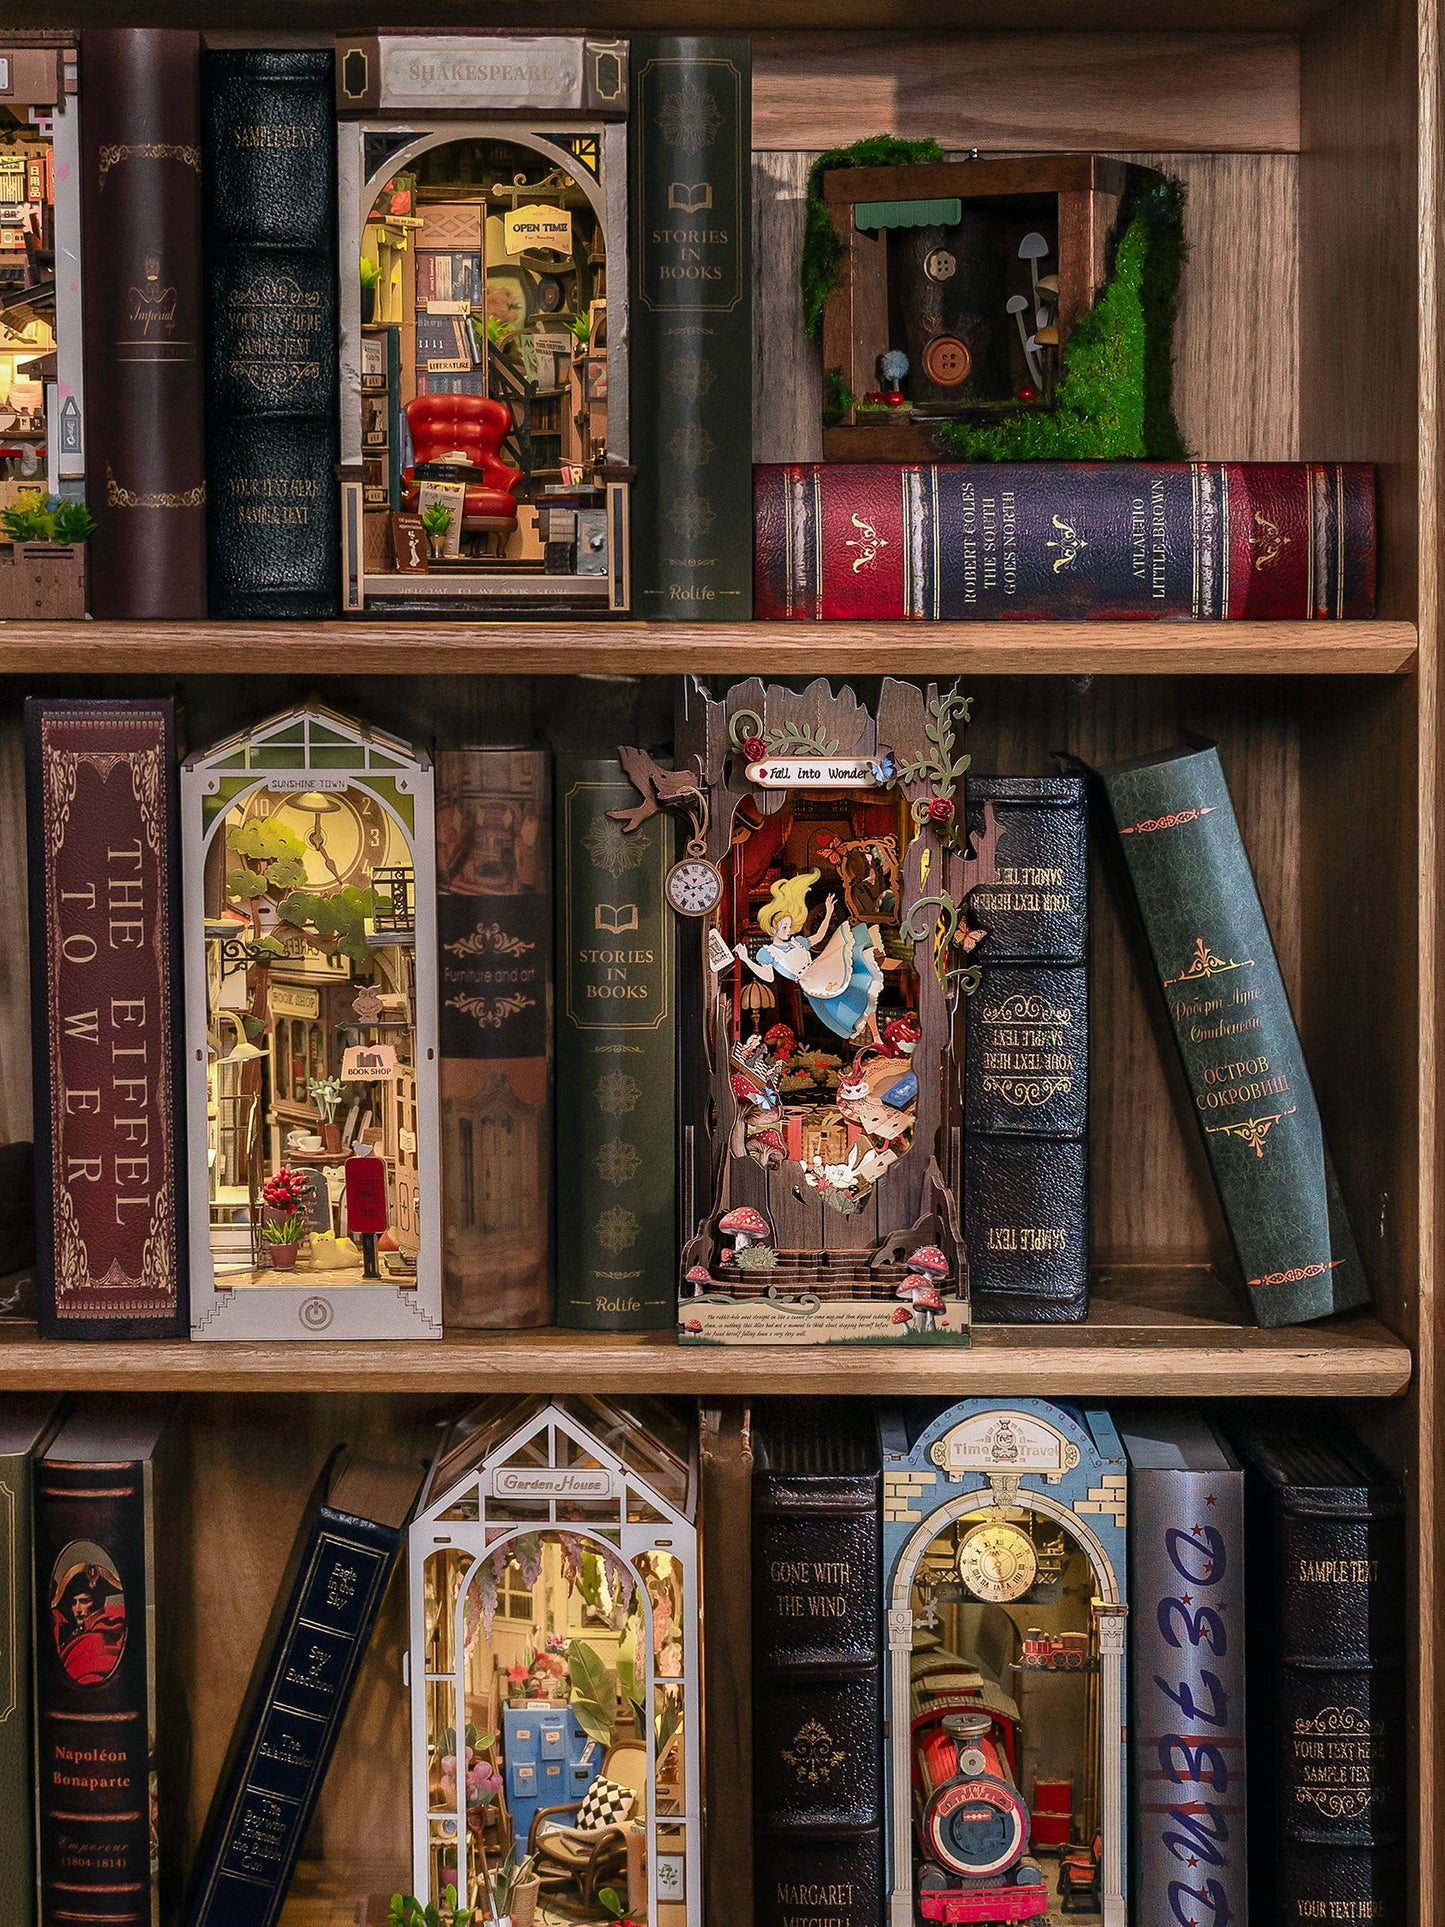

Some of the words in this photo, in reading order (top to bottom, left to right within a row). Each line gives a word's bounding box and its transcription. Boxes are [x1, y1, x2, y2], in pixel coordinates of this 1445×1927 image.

[409, 64, 555, 82] SHAKESPEARE
[513, 223, 540, 233] OPEN
[543, 223, 568, 232] TIME
[652, 229, 729, 244] STORIES
[680, 248, 702, 262] IN
[659, 264, 723, 280] BOOKS
[428, 361, 470, 371] LITERATURE
[962, 482, 976, 535] COLES
[1151, 480, 1165, 538] BROWN
[982, 498, 996, 552] SOUTH
[1002, 491, 1016, 547] NORTH
[964, 539, 977, 604] ROBERT
[983, 557, 997, 590] THE
[1004, 551, 1017, 595] GOES
[1152, 543, 1166, 599] LITTLE
[668, 585, 716, 601] Rolife
[769, 766, 792, 780] Fall
[797, 766, 822, 780] into
[828, 766, 870, 780] Wonder
[271, 779, 316, 789] SUNSHINE
[319, 779, 346, 789] TOWN
[361, 798, 373, 816] 2
[370, 829, 380, 848] 3
[1021, 867, 1064, 886] SAMPLE
[107, 838, 145, 951] THE
[1013, 893, 1040, 911] TEXT
[579, 949, 655, 964] STORIES
[444, 966, 492, 984] Furniture
[494, 968, 519, 983] and
[519, 968, 535, 982] art
[606, 967, 628, 982] IN
[272, 992, 294, 1005] BOOK
[295, 995, 316, 1008] SHOP
[586, 984, 649, 999] BOOKS
[1170, 996, 1224, 1022] Роберт
[60, 882, 103, 1185] TOWER
[992, 1030, 1020, 1047] TEXT
[982, 1053, 1012, 1070] HERE
[1013, 1053, 1041, 1070] TEXT
[1043, 1053, 1074, 1070] YOUR
[1203, 1056, 1270, 1085] ОСТРОВ
[1196, 1075, 1291, 1110] СОКРОВИЩ
[110, 995, 151, 1226] EIFFEL
[987, 1228, 1018, 1250] TEXT
[1019, 1228, 1067, 1250] SAMPLE
[595, 1296, 641, 1312] Rolife
[953, 1443, 990, 1455] Time
[1018, 1445, 1060, 1457] Travel
[503, 1473, 553, 1491] Garden
[553, 1474, 602, 1492] House
[332, 1562, 357, 1582] Eagle
[770, 1561, 810, 1584] GONE
[813, 1561, 850, 1585] WITH
[1300, 1560, 1348, 1582] SAMPLE
[1349, 1560, 1379, 1582] TEXT
[326, 1591, 348, 1610] Sky
[776, 1595, 805, 1617] THE
[807, 1595, 847, 1617] WIND
[285, 1667, 334, 1693] Execution
[282, 1733, 301, 1751] The
[1293, 1741, 1326, 1759] YOUR
[1327, 1741, 1356, 1759] TEXT
[54, 1745, 127, 1764] Napoléon
[53, 1771, 131, 1791] Bonaparte
[1304, 1765, 1347, 1783] SAMPLE
[955, 1792, 996, 1803] TRAVEL
[962, 1786, 986, 1795] TIME
[61, 1857, 127, 1868] (1804-1814)
[777, 1883, 854, 1905] MARGARET
[1297, 1899, 1326, 1918] YOUR
[1328, 1900, 1357, 1918] TEXT
